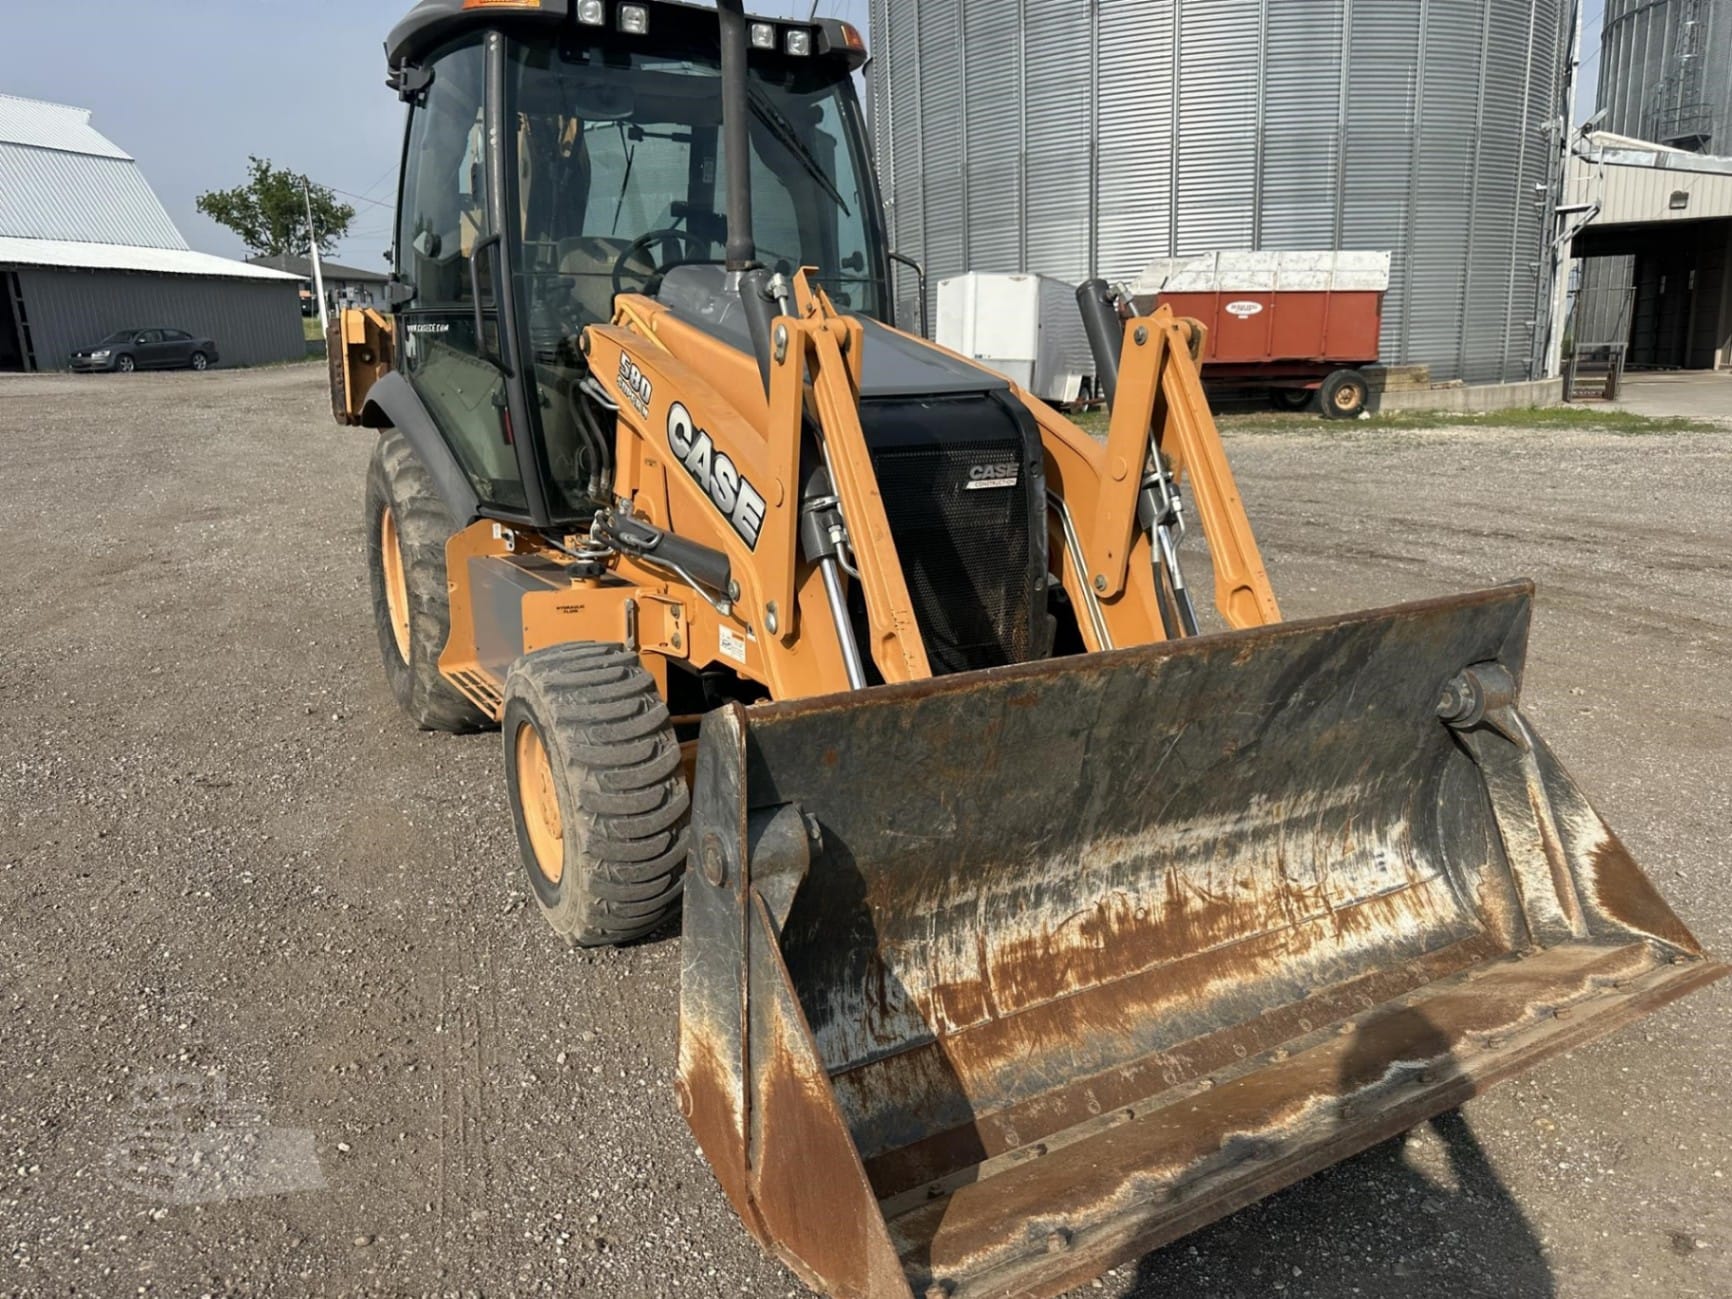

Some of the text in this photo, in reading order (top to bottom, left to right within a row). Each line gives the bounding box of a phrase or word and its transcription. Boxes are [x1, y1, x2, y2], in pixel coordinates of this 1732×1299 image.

[619, 349, 653, 405] 580
[667, 401, 767, 552] CASE
[969, 462, 1020, 480] CASE
